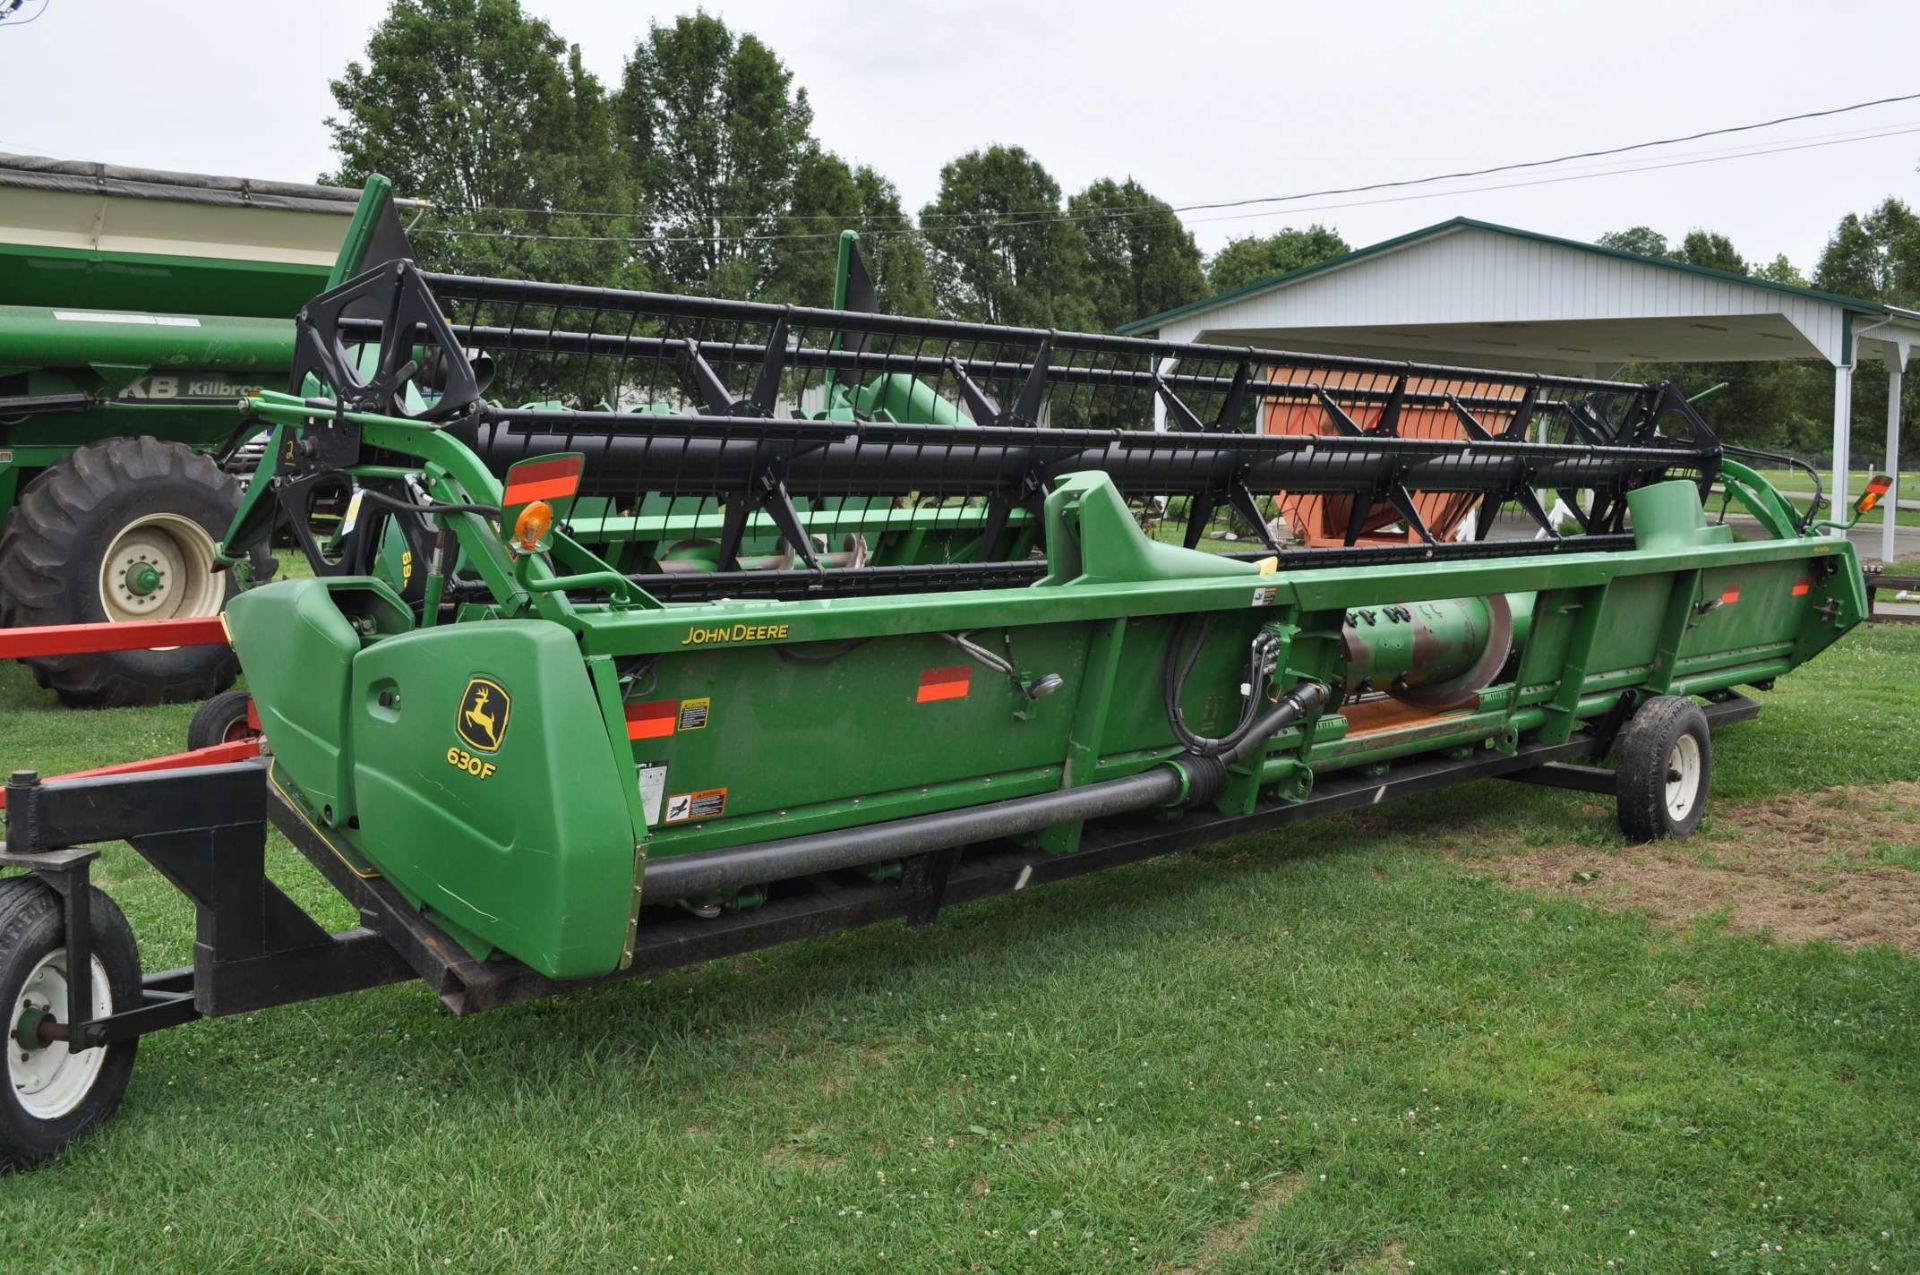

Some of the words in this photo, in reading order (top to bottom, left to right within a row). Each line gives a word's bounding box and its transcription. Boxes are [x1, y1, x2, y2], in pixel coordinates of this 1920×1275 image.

[118, 376, 179, 398] KB
[681, 627, 731, 645] JOHN
[732, 624, 789, 642] DEERE
[447, 747, 497, 779] 630F
